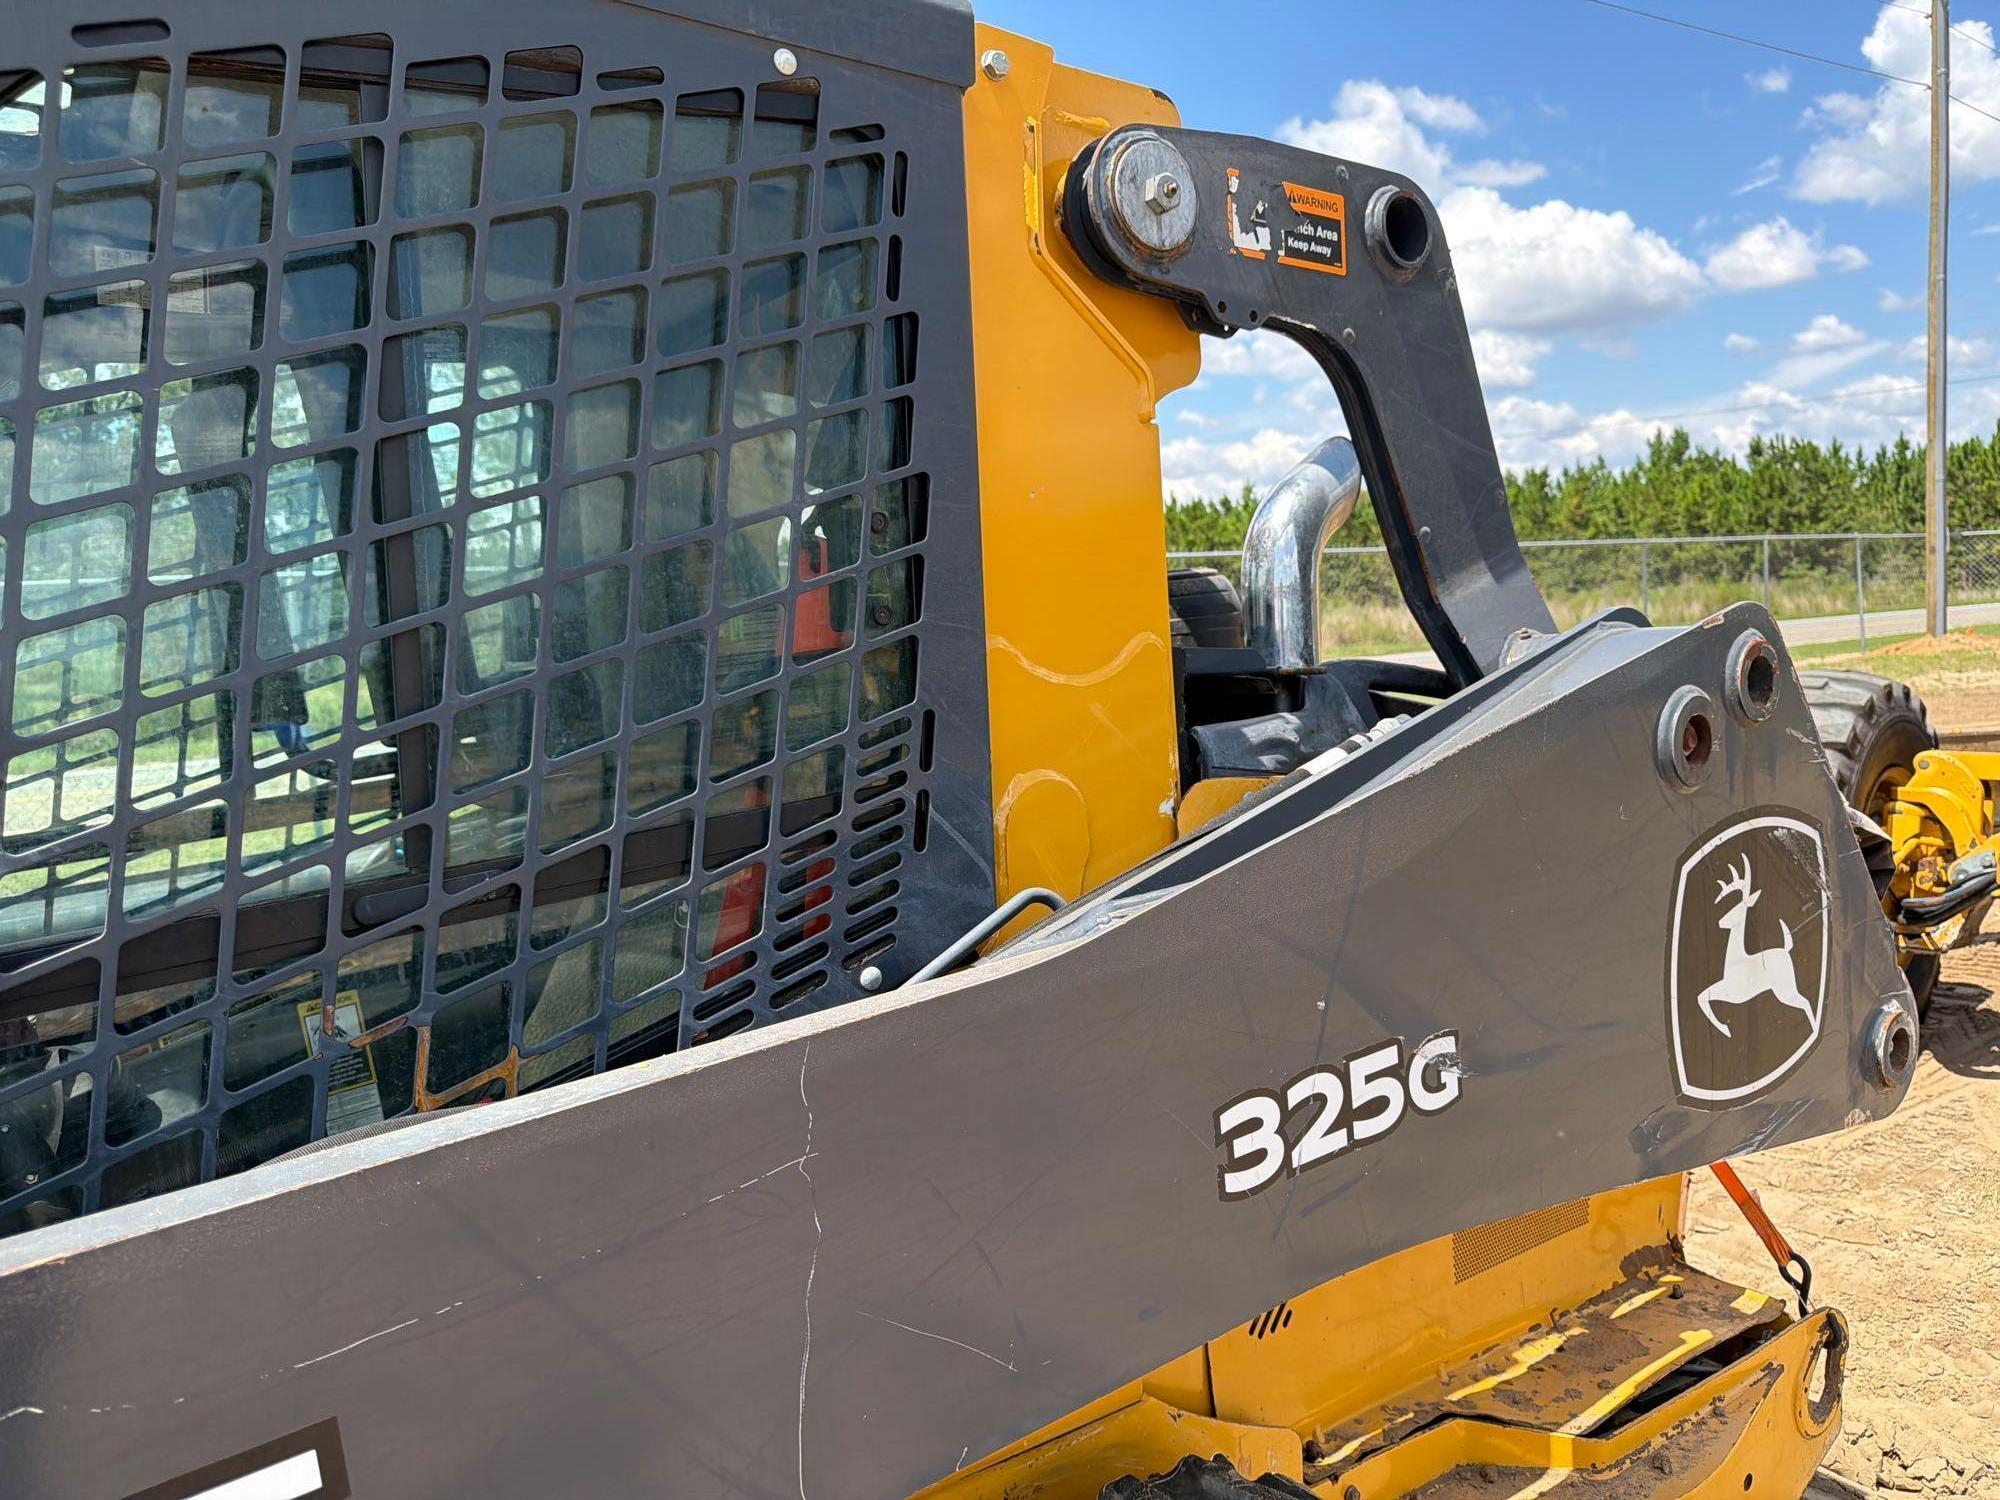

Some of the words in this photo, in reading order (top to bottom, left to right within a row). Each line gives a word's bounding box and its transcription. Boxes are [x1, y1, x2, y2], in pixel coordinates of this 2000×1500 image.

[1297, 193, 1339, 212] WARNING
[1316, 225, 1338, 241] Area
[1287, 236, 1309, 252] Keep
[1310, 241, 1331, 257] Away
[1218, 1034, 1460, 1194] 325G
